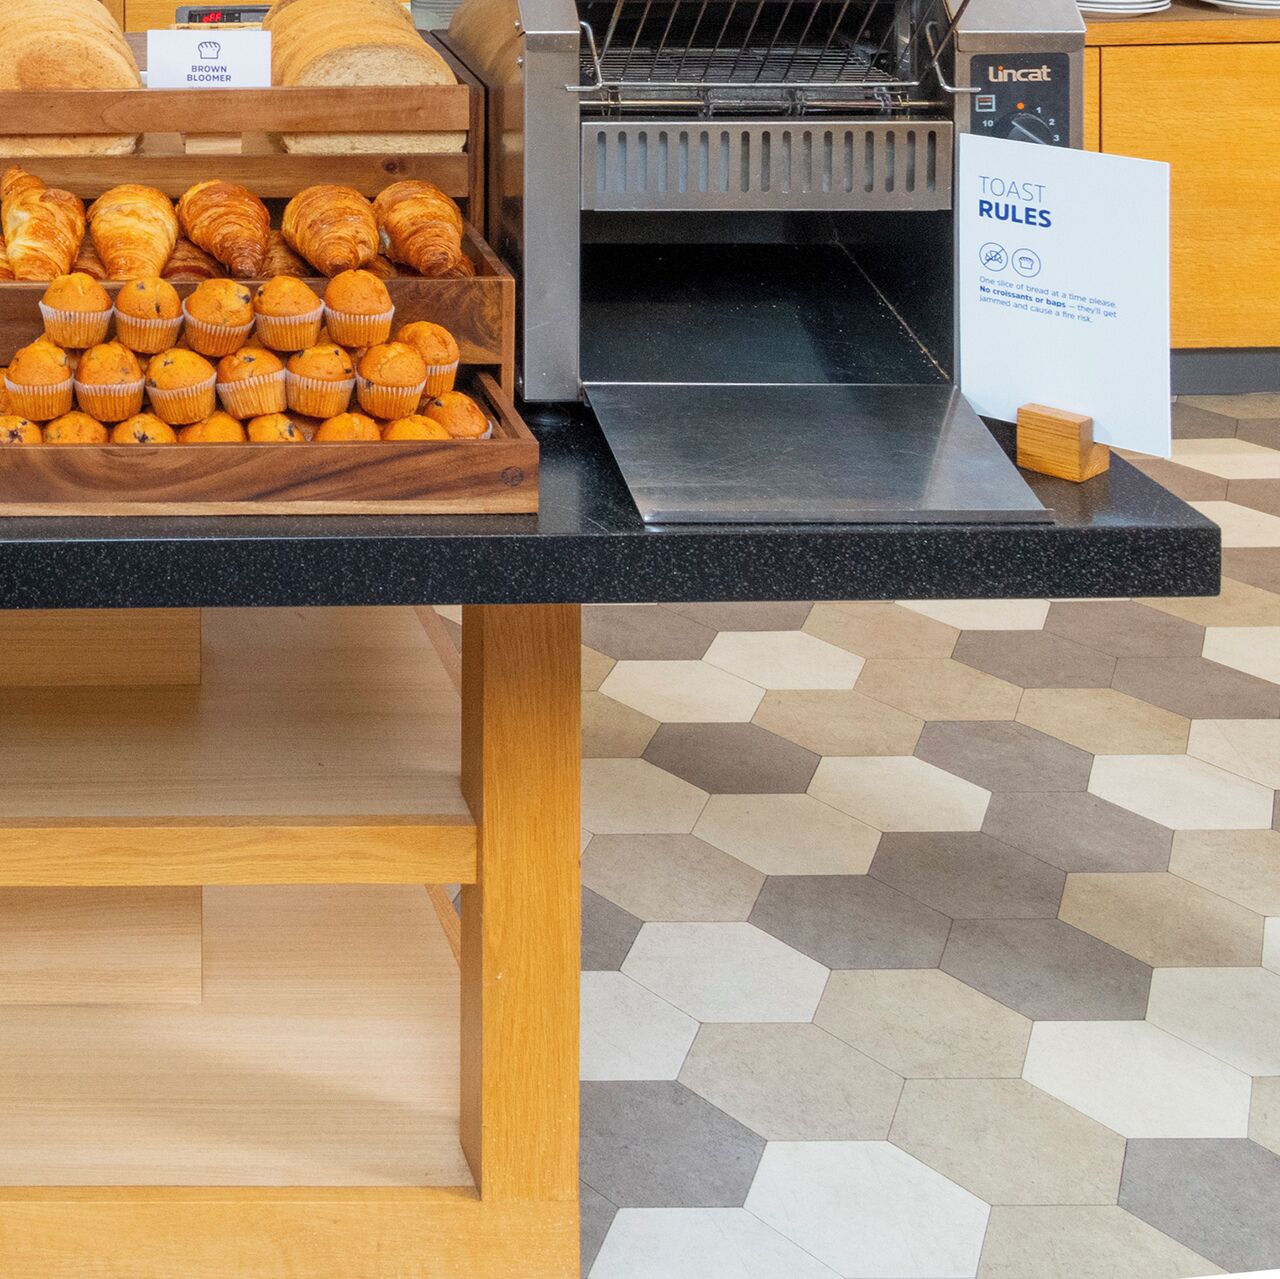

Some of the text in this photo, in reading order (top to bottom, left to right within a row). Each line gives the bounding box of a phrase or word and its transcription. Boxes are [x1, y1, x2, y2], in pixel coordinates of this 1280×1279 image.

[186, 74, 232, 82] BLOOMER
[191, 65, 227, 73] BROWN
[1054, 134, 1060, 142] 3
[978, 175, 1046, 203] TOAST
[979, 199, 1052, 228] RULES
[979, 275, 995, 285] One
[996, 278, 1014, 289] slice
[1026, 285, 1049, 296] bread
[1068, 292, 1087, 303] time
[1089, 296, 1117, 308] please.
[979, 285, 1117, 319] No croissants or baps they'll get
[979, 294, 1011, 308] jammed
[1012, 301, 1028, 311] and
[1030, 305, 1053, 316] cause
[1062, 311, 1075, 320] fire
